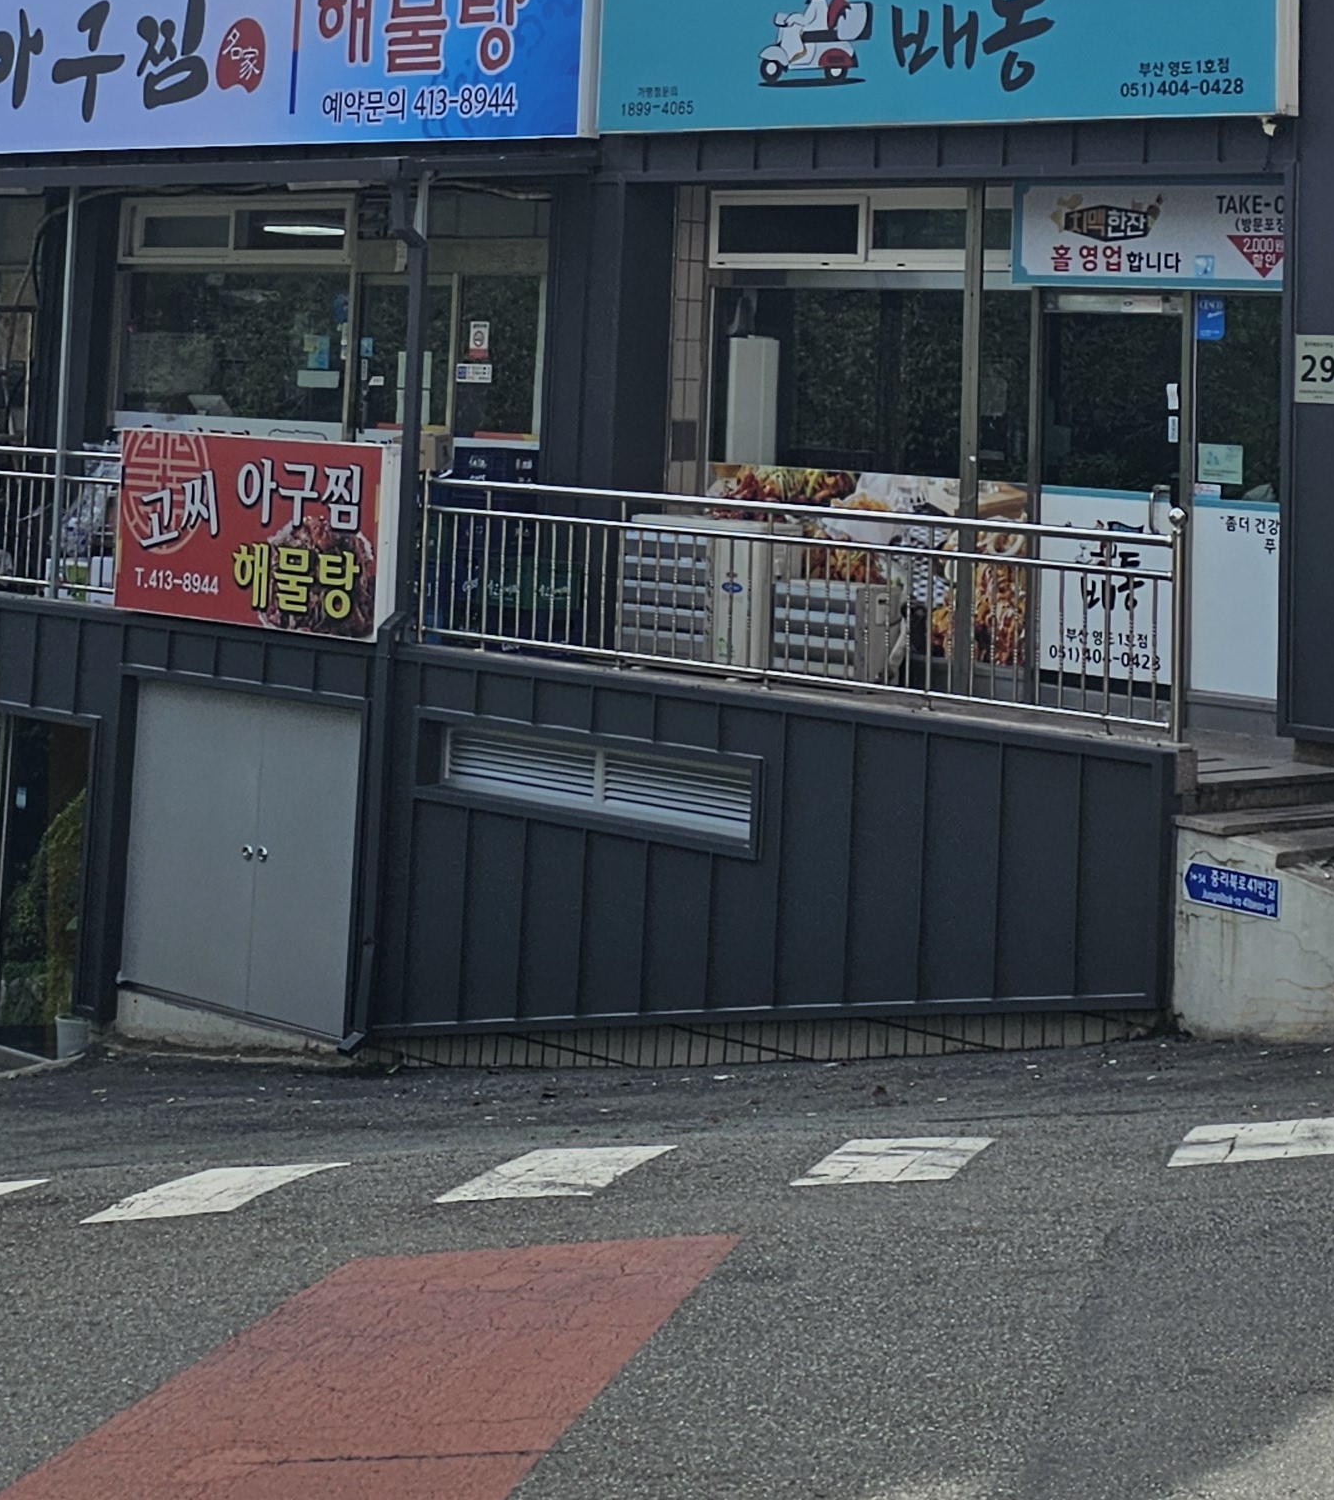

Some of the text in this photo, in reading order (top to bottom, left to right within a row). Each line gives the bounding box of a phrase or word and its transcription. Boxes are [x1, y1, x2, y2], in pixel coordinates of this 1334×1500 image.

[221, 26, 261, 81] 名家
[1138, 57, 1229, 78] 부산 영도 1호점
[1120, 77, 1244, 98] 051)404-0428
[322, 85, 516, 123] 예약문의 413-8944
[621, 100, 694, 117] 1899-4065
[1050, 244, 1072, 272] 홀
[1252, 253, 1276, 268] 할인
[237, 457, 363, 531] 아구찜
[139, 470, 219, 548] 고씨
[134, 566, 219, 595] T.413-8944
[232, 542, 360, 619] 해물탕
